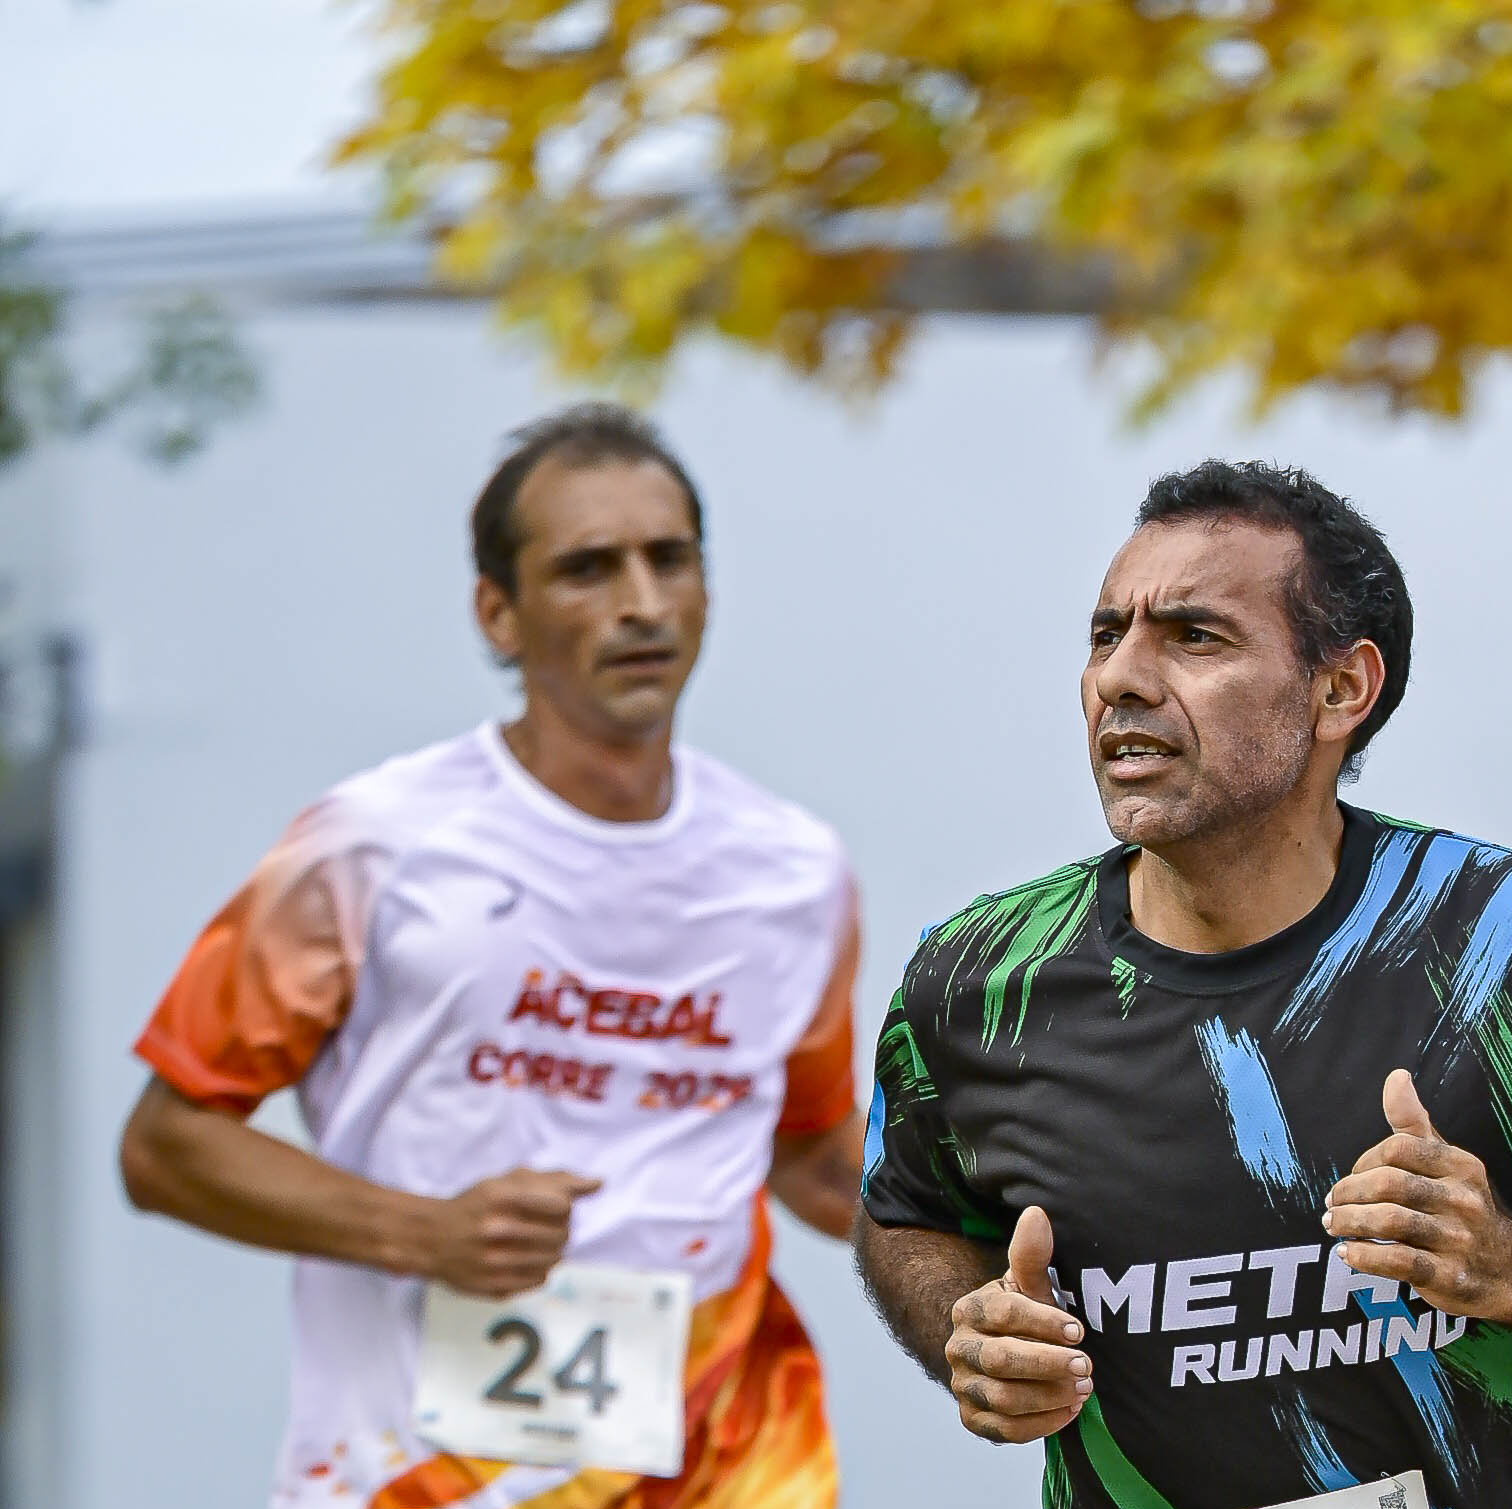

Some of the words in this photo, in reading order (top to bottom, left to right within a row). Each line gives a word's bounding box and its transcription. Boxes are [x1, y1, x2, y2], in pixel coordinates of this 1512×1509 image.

[508, 968, 733, 1047] ACEBAL
[467, 1040, 616, 1102] CORRE
[483, 1316, 619, 1415] 24
